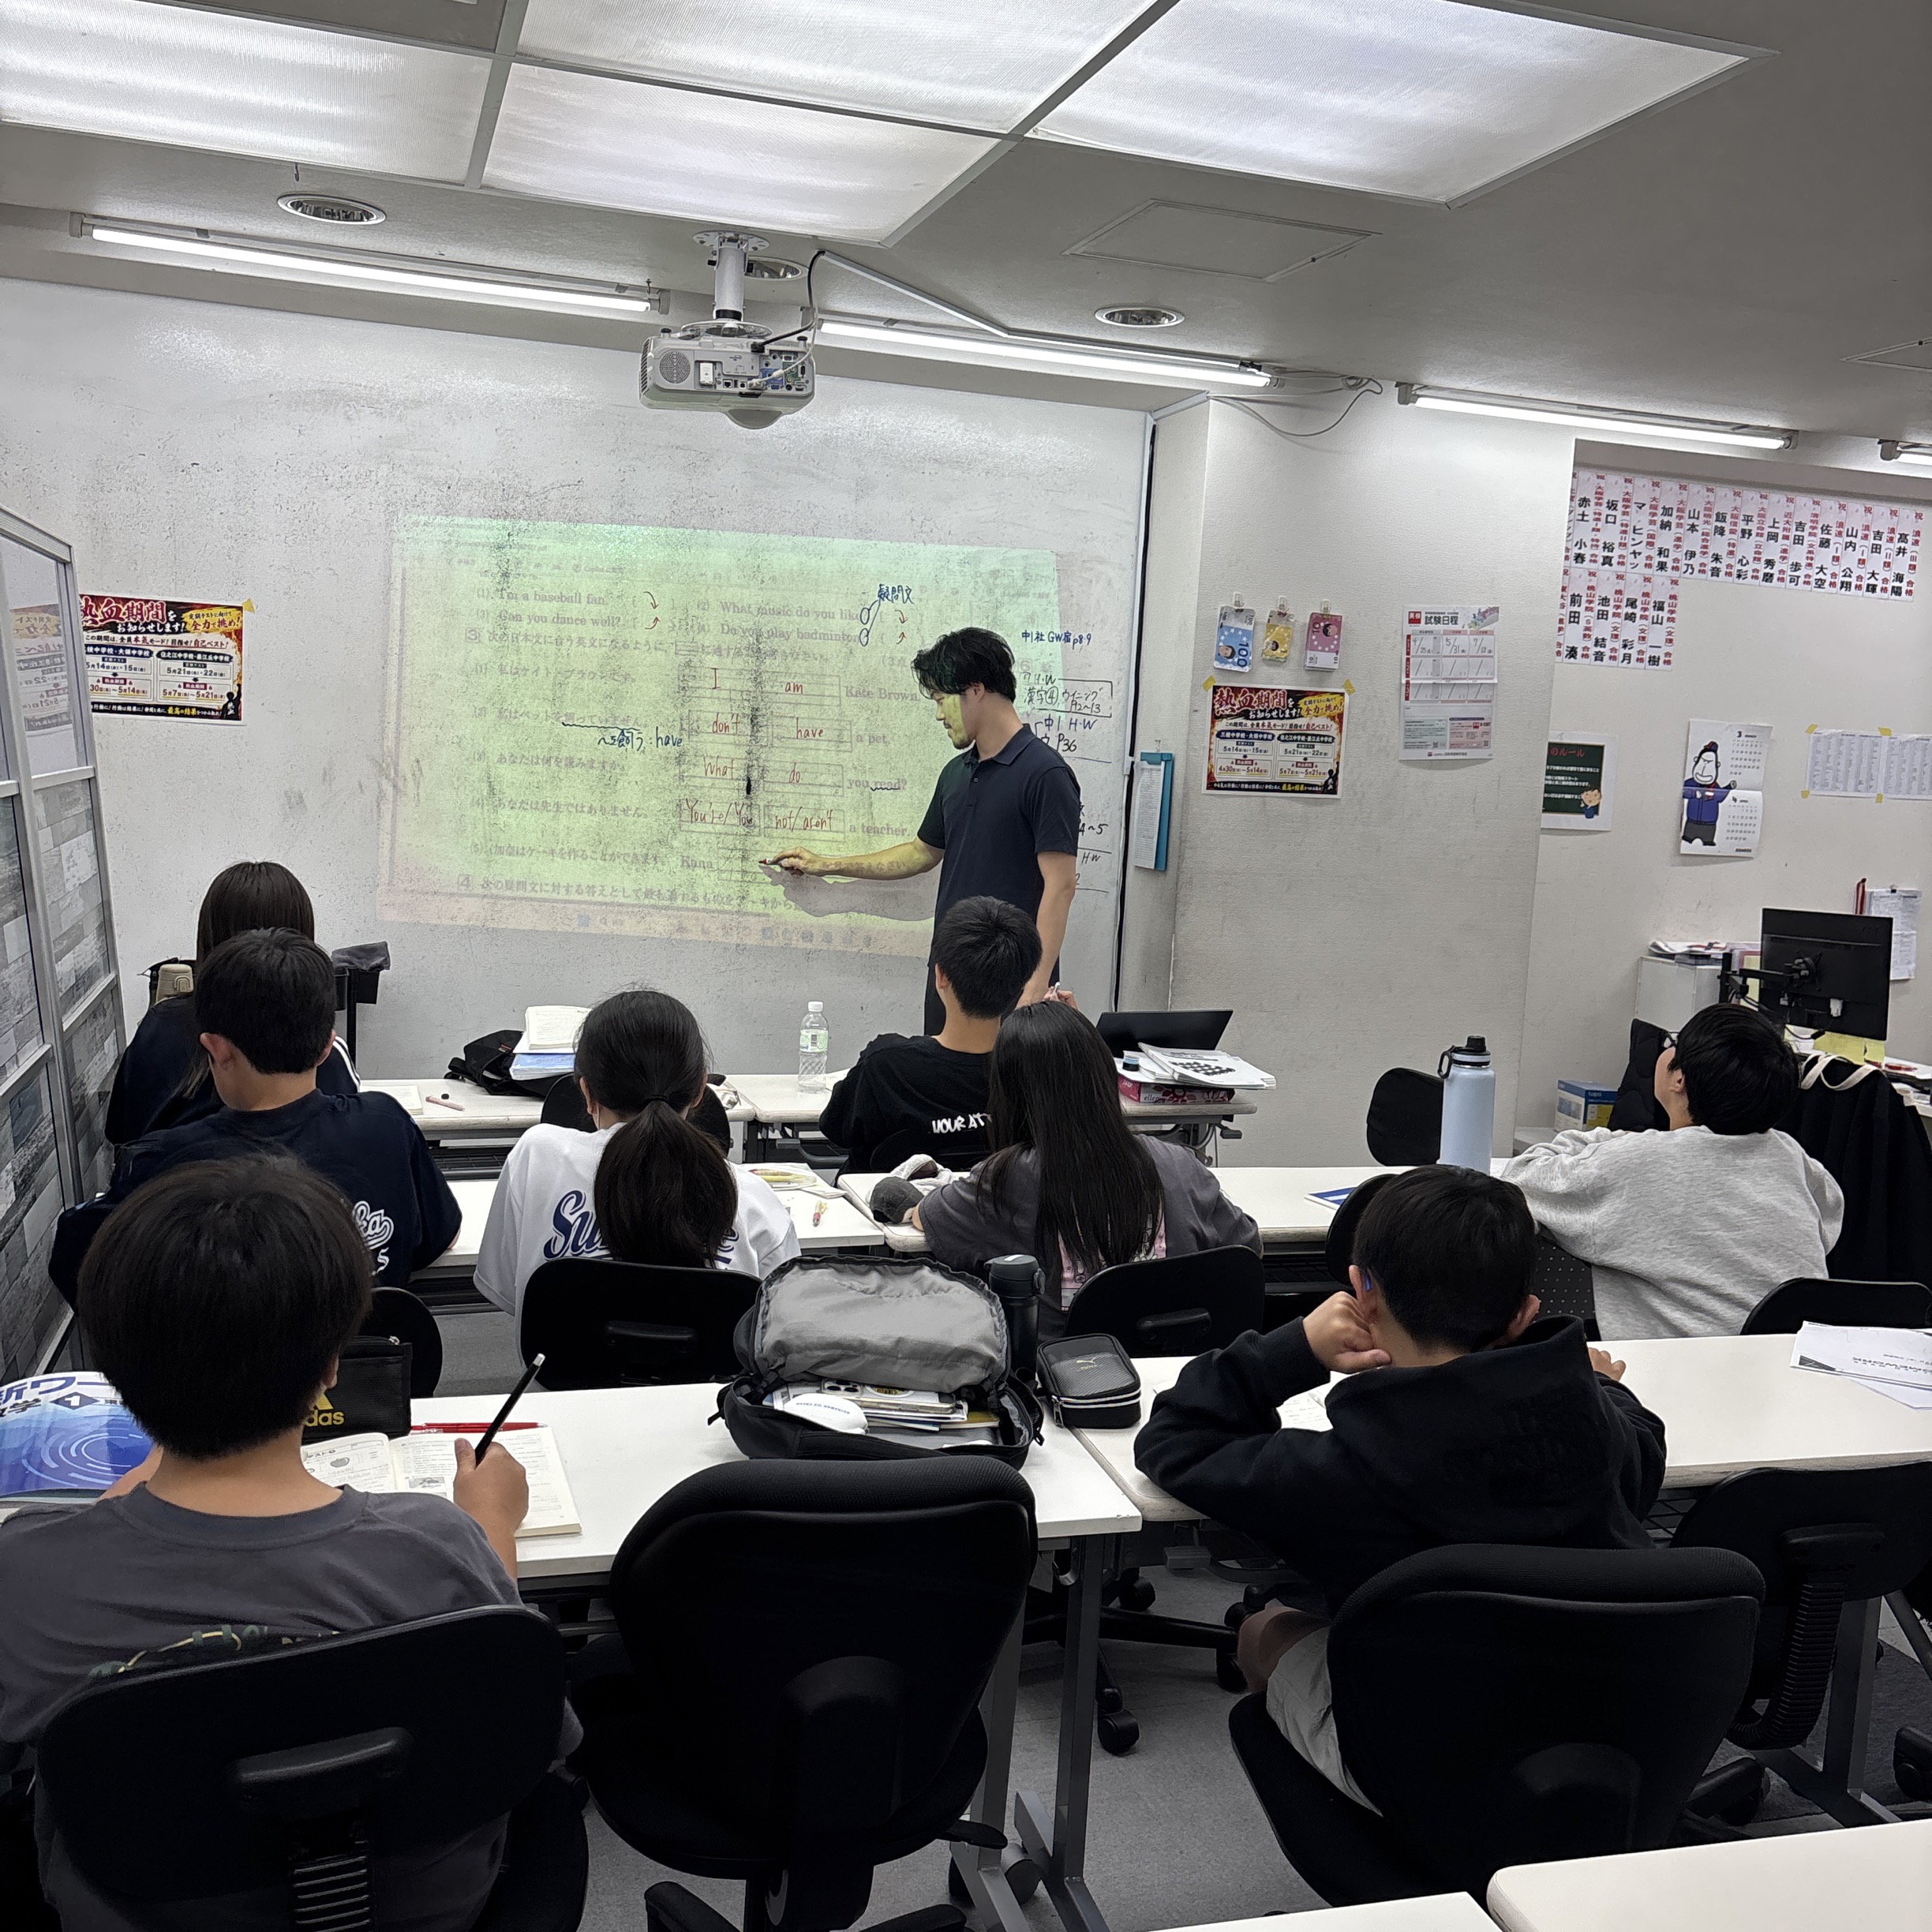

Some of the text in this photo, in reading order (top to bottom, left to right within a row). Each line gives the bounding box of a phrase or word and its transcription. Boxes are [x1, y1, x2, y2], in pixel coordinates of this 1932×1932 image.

[1574, 496, 1591, 564] 赤土 小春
[1601, 500, 1619, 567] 坂口 裕真
[1793, 522, 1807, 545] 吉田
[1656, 506, 1673, 572] 加納 和果
[1683, 509, 1700, 575] 山本 伊乃
[1844, 527, 1858, 552] 山内
[1870, 530, 1884, 554] 吉田
[1735, 515, 1754, 580] 平野 心彩
[1589, 553, 1598, 563] 合格
[1617, 554, 1626, 566] 合格
[1645, 555, 1653, 568] 合格
[1672, 558, 1680, 571] 合格
[1814, 524, 1833, 589] 佐藤 大空
[1698, 562, 1707, 574] 合格
[1724, 564, 1734, 577] 合格
[1751, 568, 1759, 580] 合格
[1777, 569, 1786, 582] 合格
[1803, 574, 1812, 585] 合格
[1829, 572, 1838, 588] 合格
[1855, 575, 1863, 591] 合格
[1881, 578, 1889, 593] 合格
[878, 584, 914, 604] 疑問文
[1905, 580, 1914, 596] 合格
[534, 592, 582, 605] baseball
[721, 601, 751, 614] What
[796, 607, 811, 618] do
[814, 609, 835, 620] you
[1569, 593, 1582, 624] 前田
[527, 614, 548, 625] you
[552, 613, 586, 626] dance
[1425, 616, 1458, 625] 試験日程
[1593, 595, 1610, 662] 池田 結音
[1648, 601, 1665, 667] 福山 一樹
[1237, 642, 1249, 668] 100
[1581, 646, 1590, 659] 合格
[1608, 647, 1618, 661] 合格
[1621, 639, 1634, 665] 彩月
[1636, 650, 1646, 663] 合格
[1663, 652, 1672, 665] 合格
[785, 682, 803, 695] am
[844, 685, 875, 698] Kate
[712, 713, 823, 739] don't have
[656, 726, 683, 747] have
[703, 756, 800, 784] What do
[847, 777, 869, 789] you
[65, 1395, 81, 1406] 1
